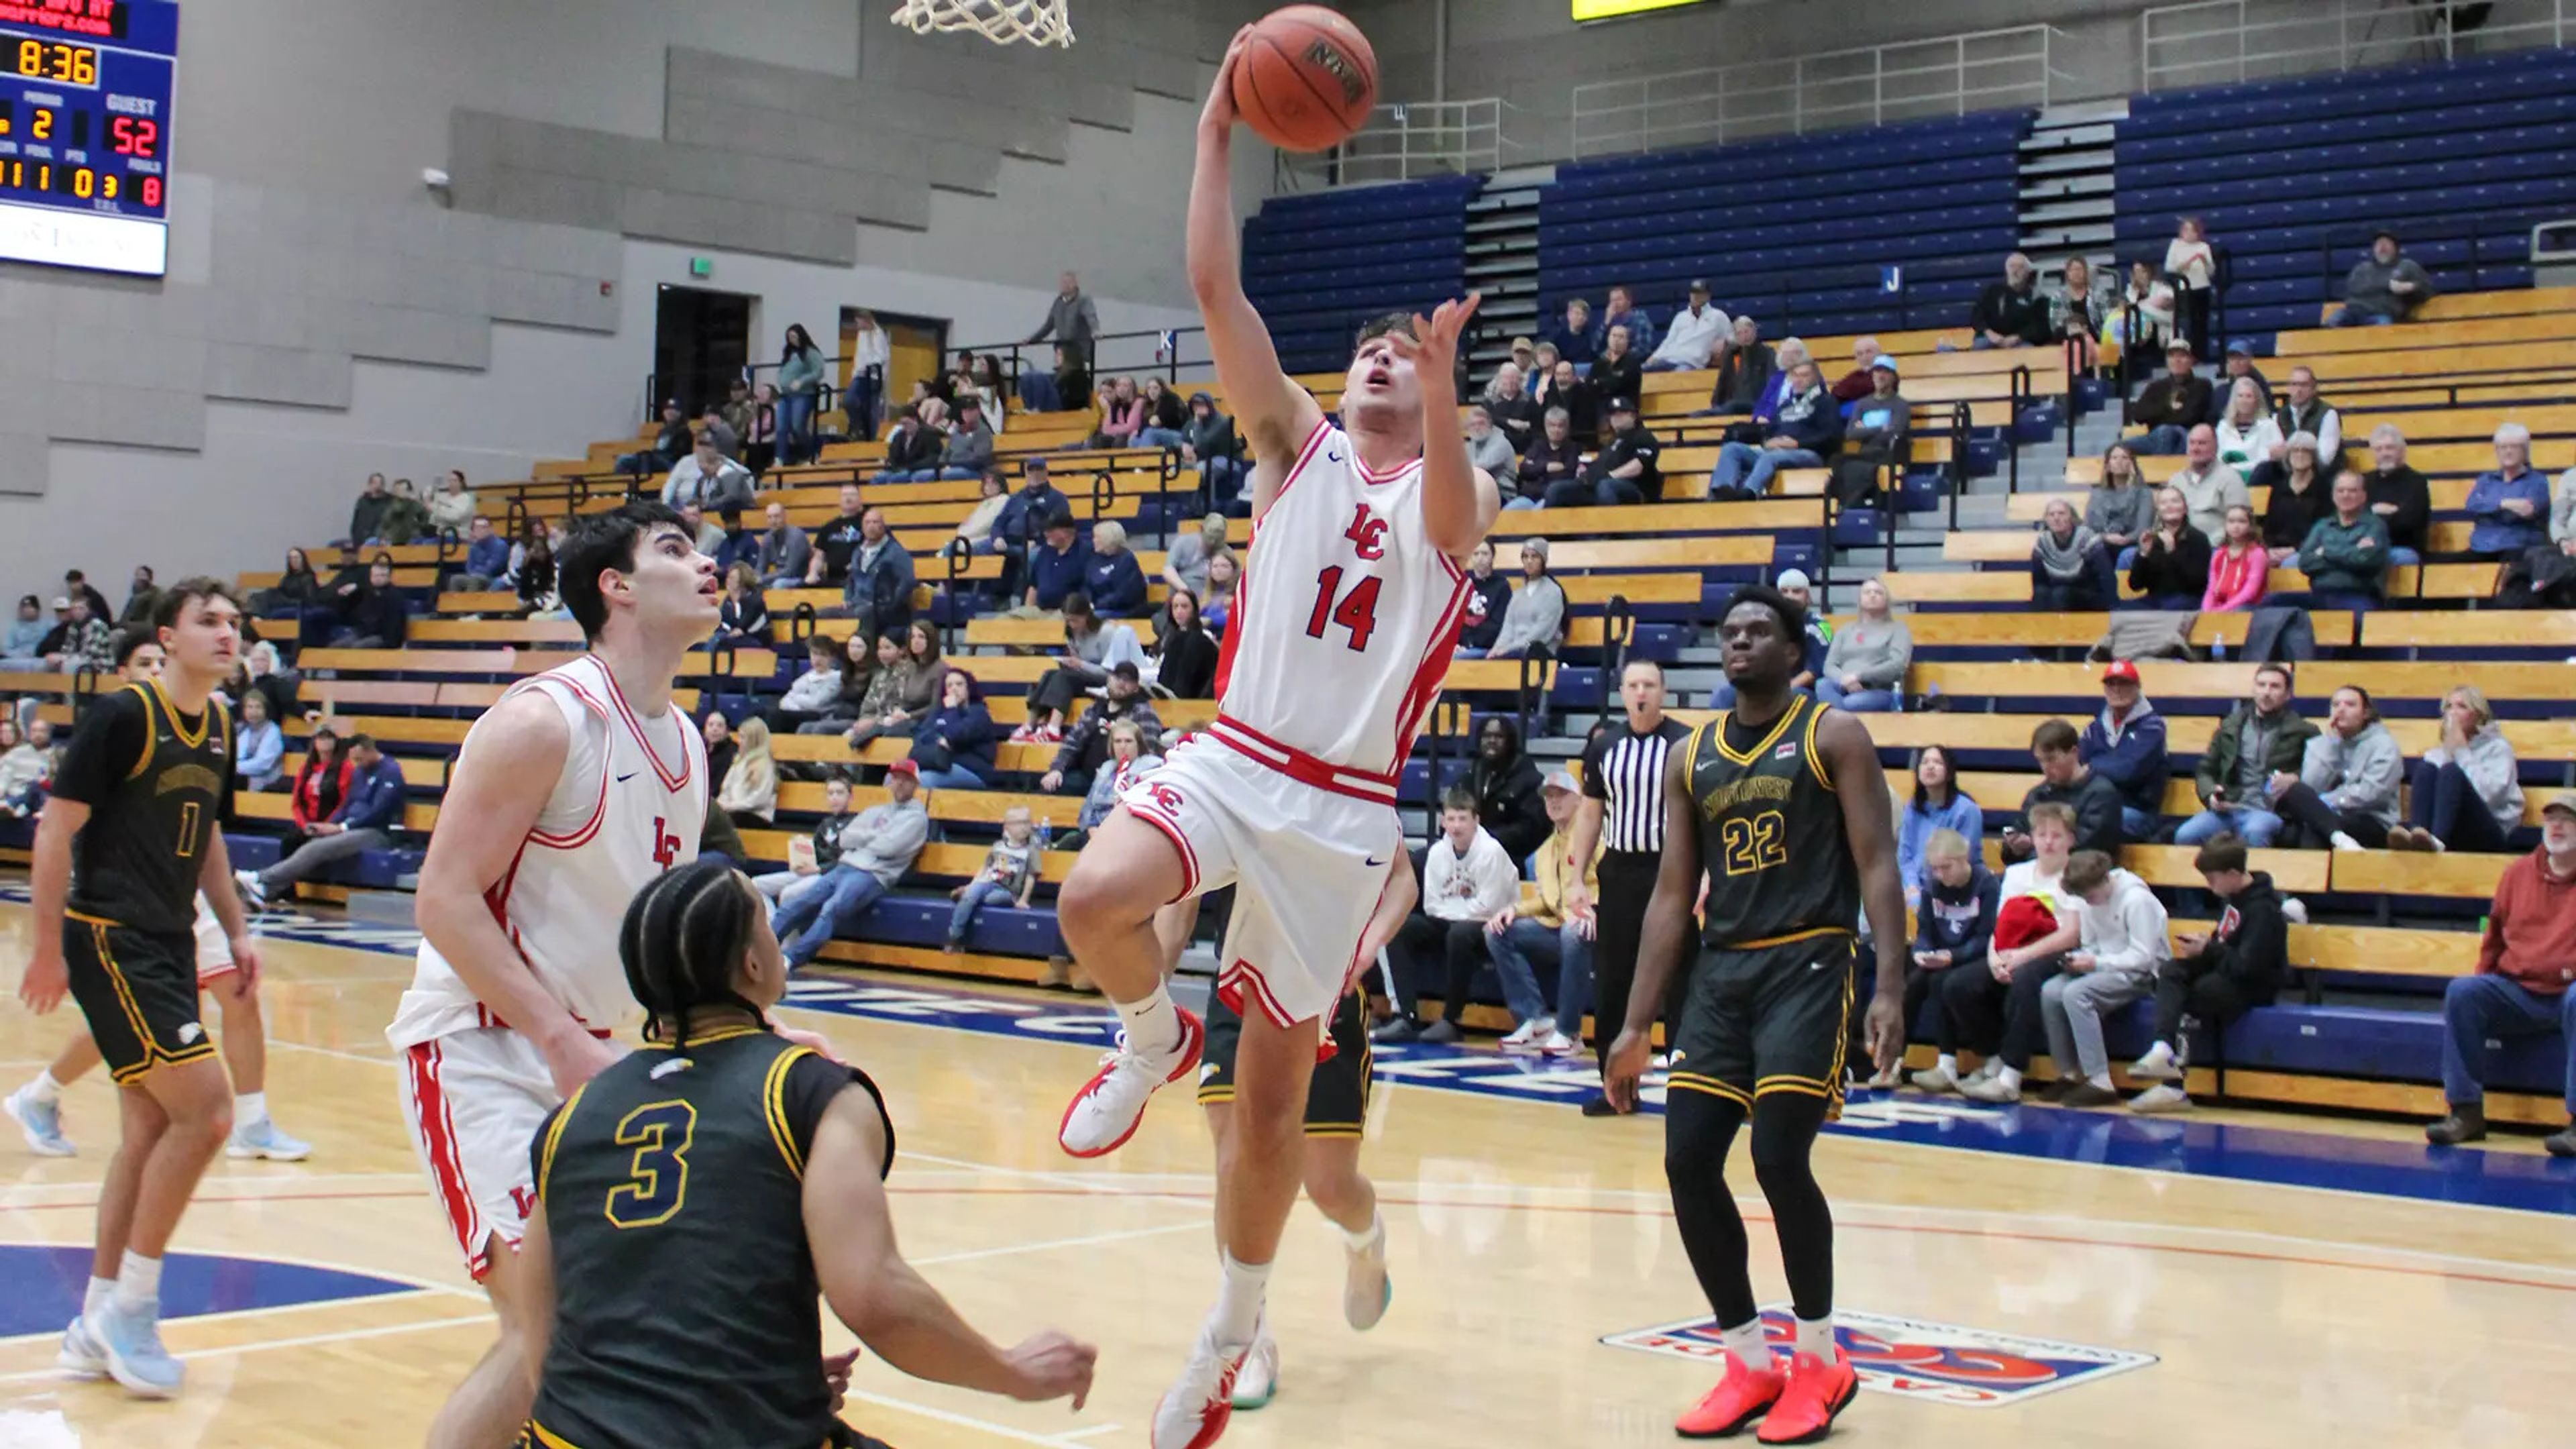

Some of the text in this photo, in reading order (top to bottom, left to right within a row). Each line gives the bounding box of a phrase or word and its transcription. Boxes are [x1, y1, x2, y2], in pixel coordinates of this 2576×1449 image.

[19, 40, 94, 85] 8:36
[32, 108, 54, 140] 2
[106, 93, 157, 116] GUEST
[113, 116, 158, 157] 52
[74, 168, 94, 199] 0
[103, 175, 118, 199] 3
[142, 176, 162, 207] 8
[1887, 266, 1899, 292] J
[1344, 502, 1388, 561] LC
[1305, 564, 1383, 653] 14
[176, 802, 201, 858] 1
[1722, 810, 1788, 877] 22
[604, 1098, 698, 1230] 3
